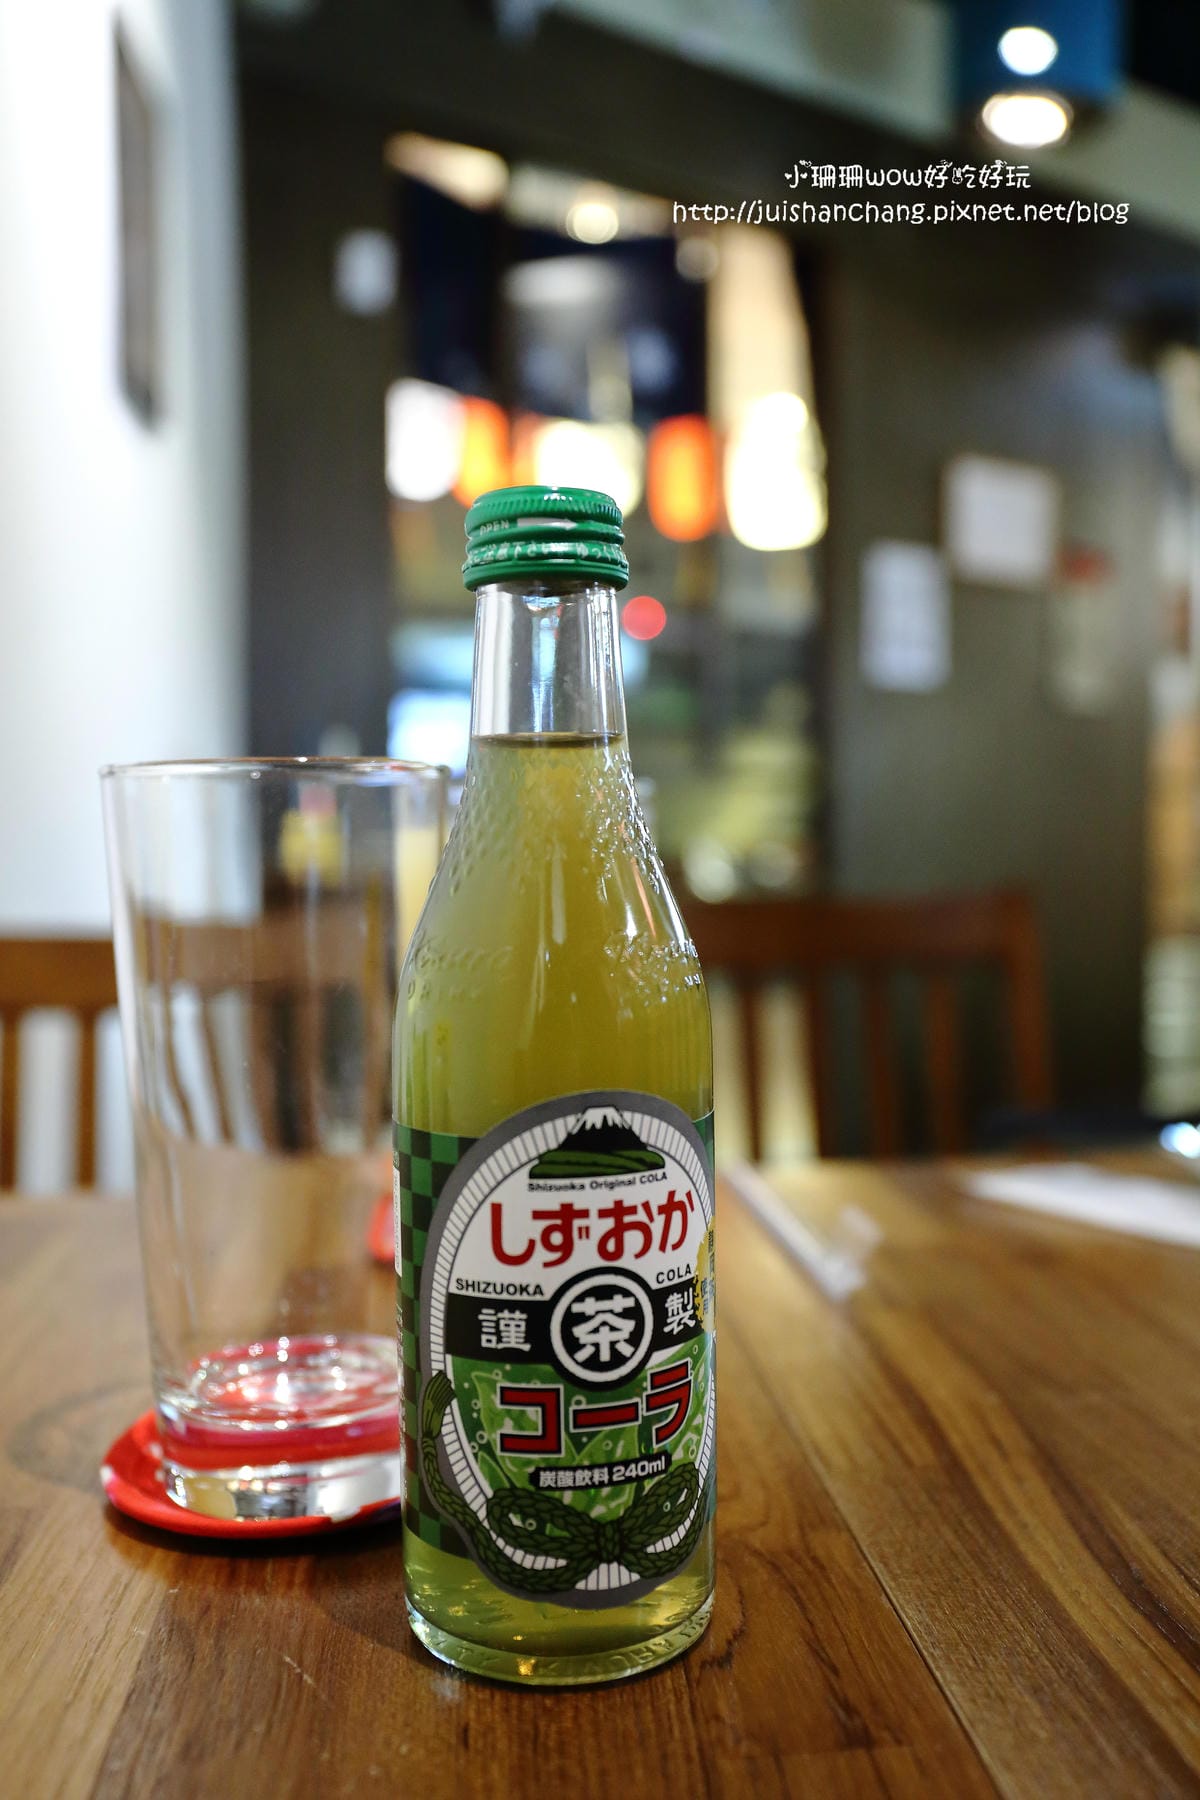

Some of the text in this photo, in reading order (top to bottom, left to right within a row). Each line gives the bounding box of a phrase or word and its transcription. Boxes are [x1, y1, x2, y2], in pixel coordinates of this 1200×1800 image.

[479, 519, 510, 536] OPEN
[528, 1171, 668, 1192] Shizuoka Original COLA
[490, 1190, 696, 1269] しずおか
[455, 1263, 692, 1297] SHIZUOKA COLA
[571, 1294, 636, 1363] 茶
[663, 1286, 697, 1335] 製
[496, 1357, 693, 1458] コーラ
[539, 1454, 666, 1489] 炭酸飲料 240ml
